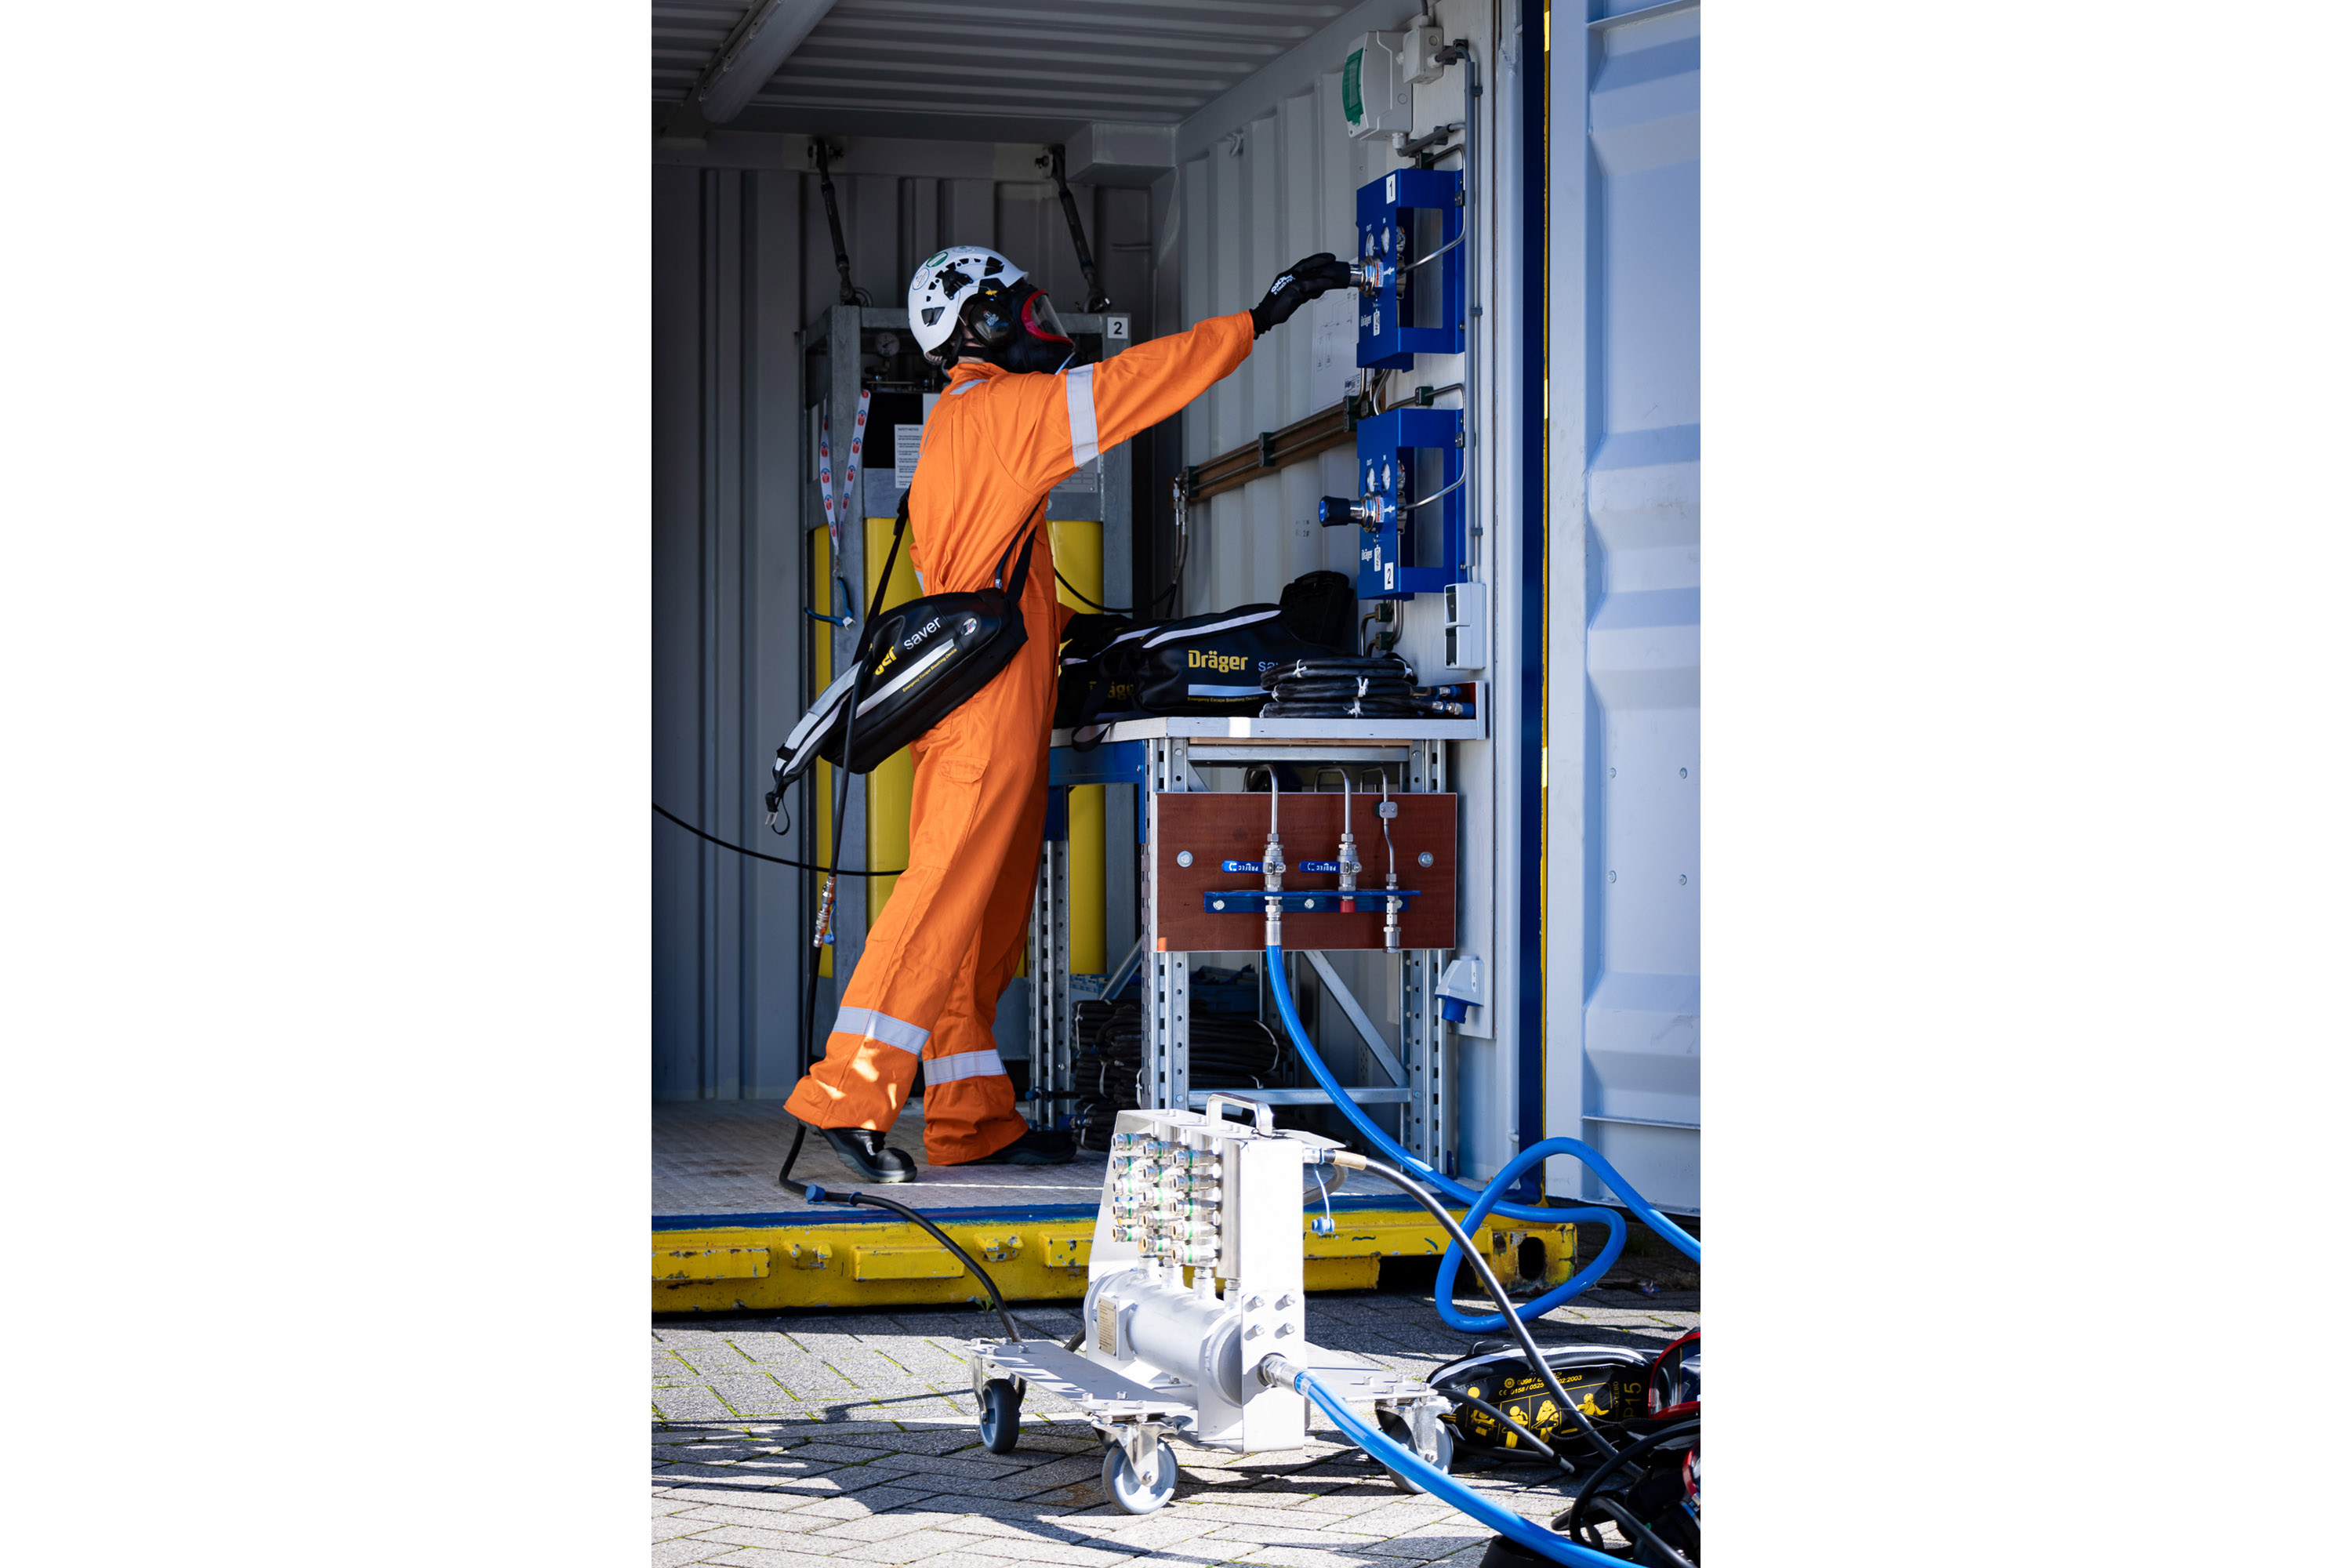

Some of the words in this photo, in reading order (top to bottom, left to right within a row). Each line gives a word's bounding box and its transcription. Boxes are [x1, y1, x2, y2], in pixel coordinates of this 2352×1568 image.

[1113, 321, 1122, 335] 2
[1386, 568, 1392, 585] 2
[903, 617, 941, 649] saver
[902, 677, 920, 692] Emergency
[919, 669, 931, 679] Escape
[931, 657, 946, 670] Breathing
[945, 648, 957, 659] Device
[1188, 649, 1248, 673] Dräger
[1510, 1386, 1526, 1396] 0158
[1529, 1381, 1545, 1390] 0525
[1558, 1374, 1582, 1385] 02:2003
